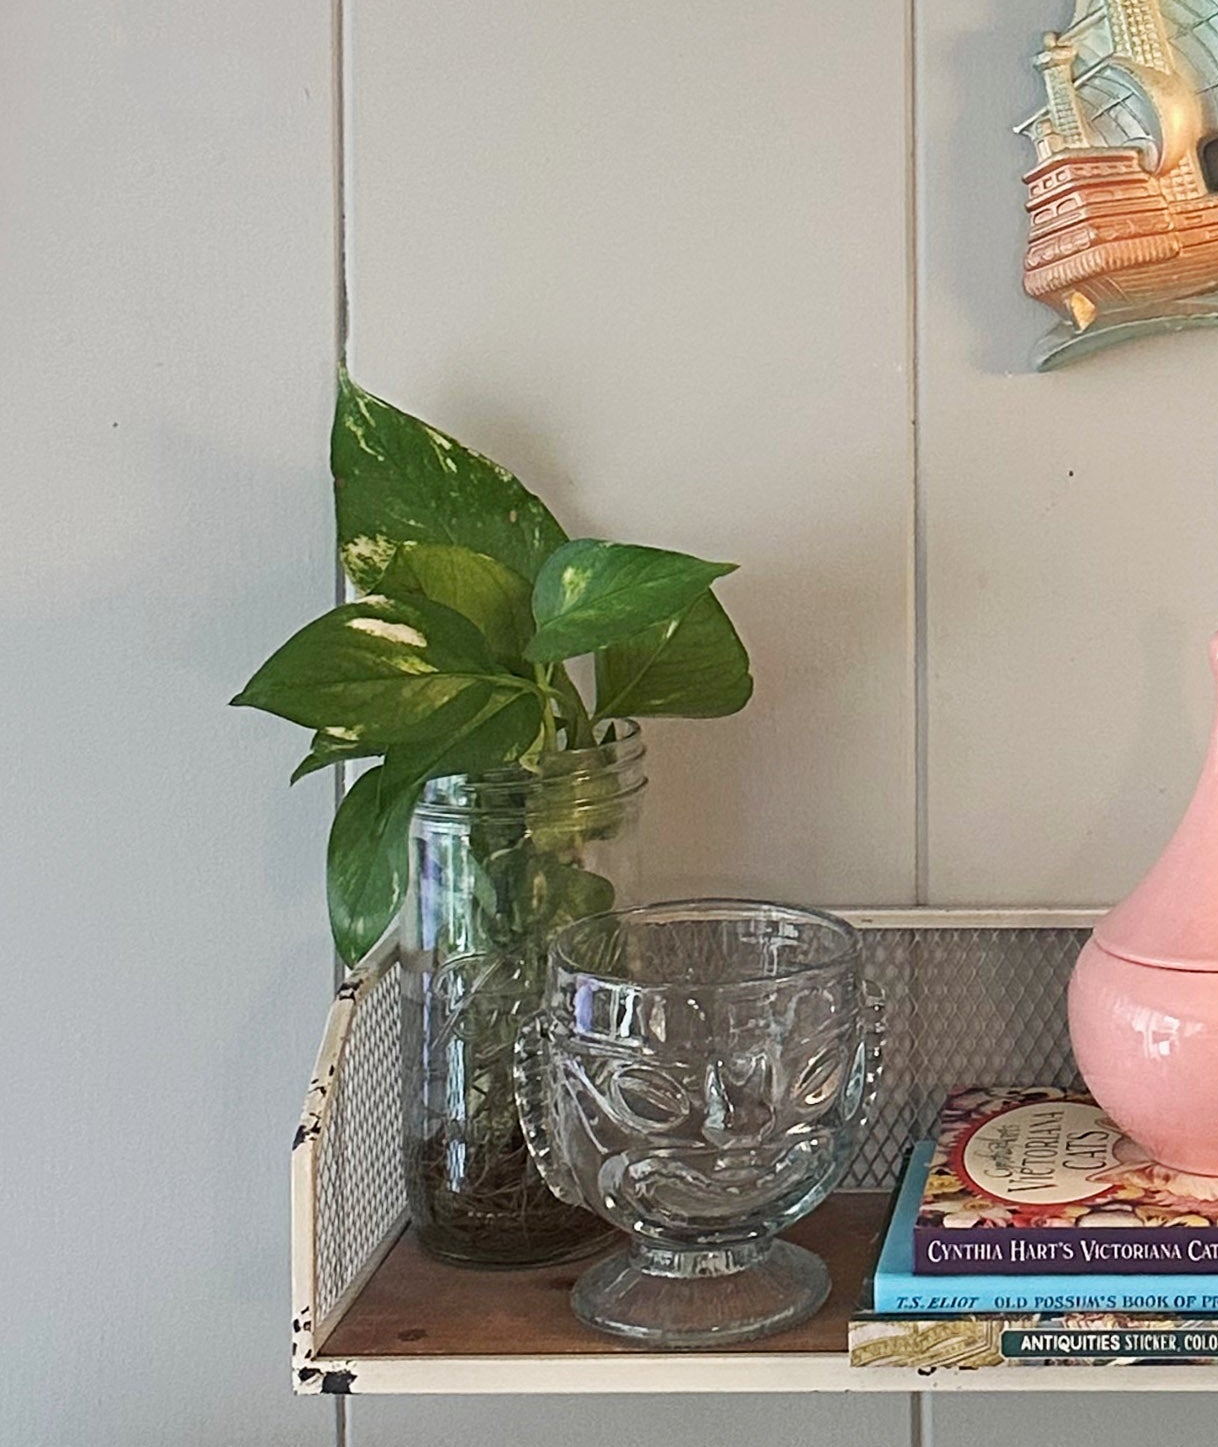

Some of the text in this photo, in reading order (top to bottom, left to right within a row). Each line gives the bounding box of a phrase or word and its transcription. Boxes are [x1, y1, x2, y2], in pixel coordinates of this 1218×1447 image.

[1062, 1130, 1110, 1170] CATS
[927, 1240, 1003, 1263] CYNTHIA
[1010, 1240, 1074, 1263] HART'S
[1080, 1240, 1182, 1263] VICTORIANA
[926, 1296, 980, 1309] ELIOT
[994, 1296, 1028, 1308] OLD
[1034, 1296, 1117, 1309] POSSUM'S
[1122, 1296, 1168, 1308] BOOK
[1174, 1295, 1196, 1308] OF
[1020, 1334, 1121, 1352] ANTIQUITIES
[1125, 1334, 1181, 1353] STICKER,
